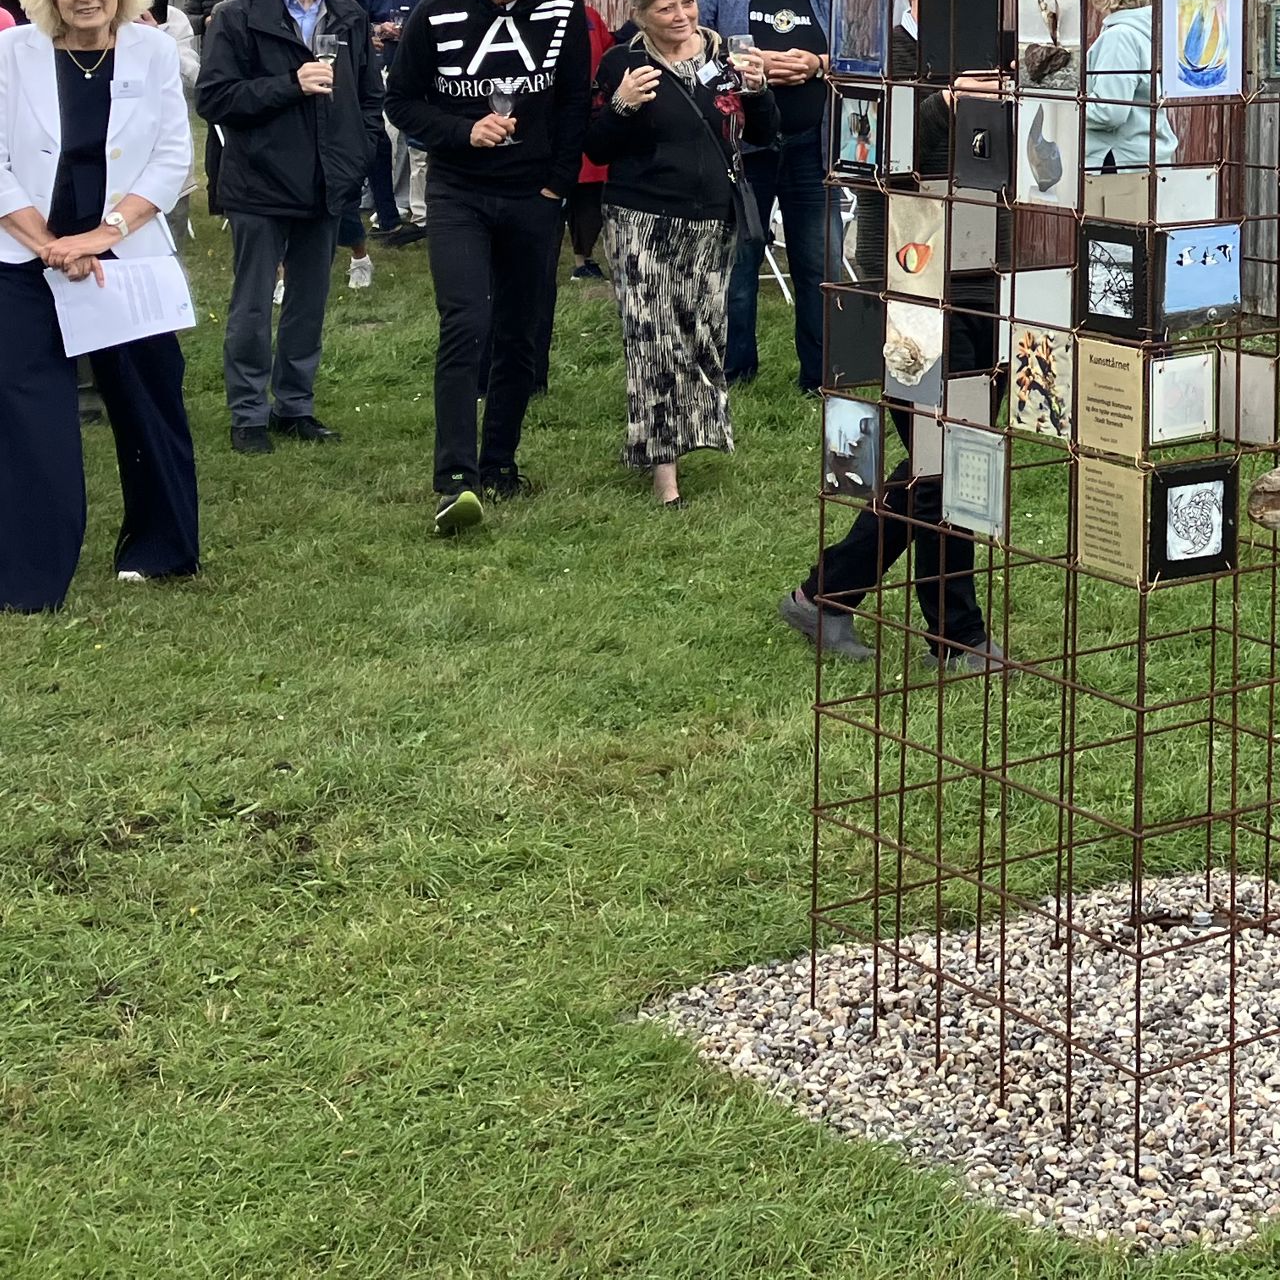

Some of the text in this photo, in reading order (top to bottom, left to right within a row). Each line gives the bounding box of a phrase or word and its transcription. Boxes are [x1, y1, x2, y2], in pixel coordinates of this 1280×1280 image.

[749, 10, 763, 22] GO
[429, 0, 574, 76] EA7
[1089, 353, 1130, 372] Kunsttårnet
